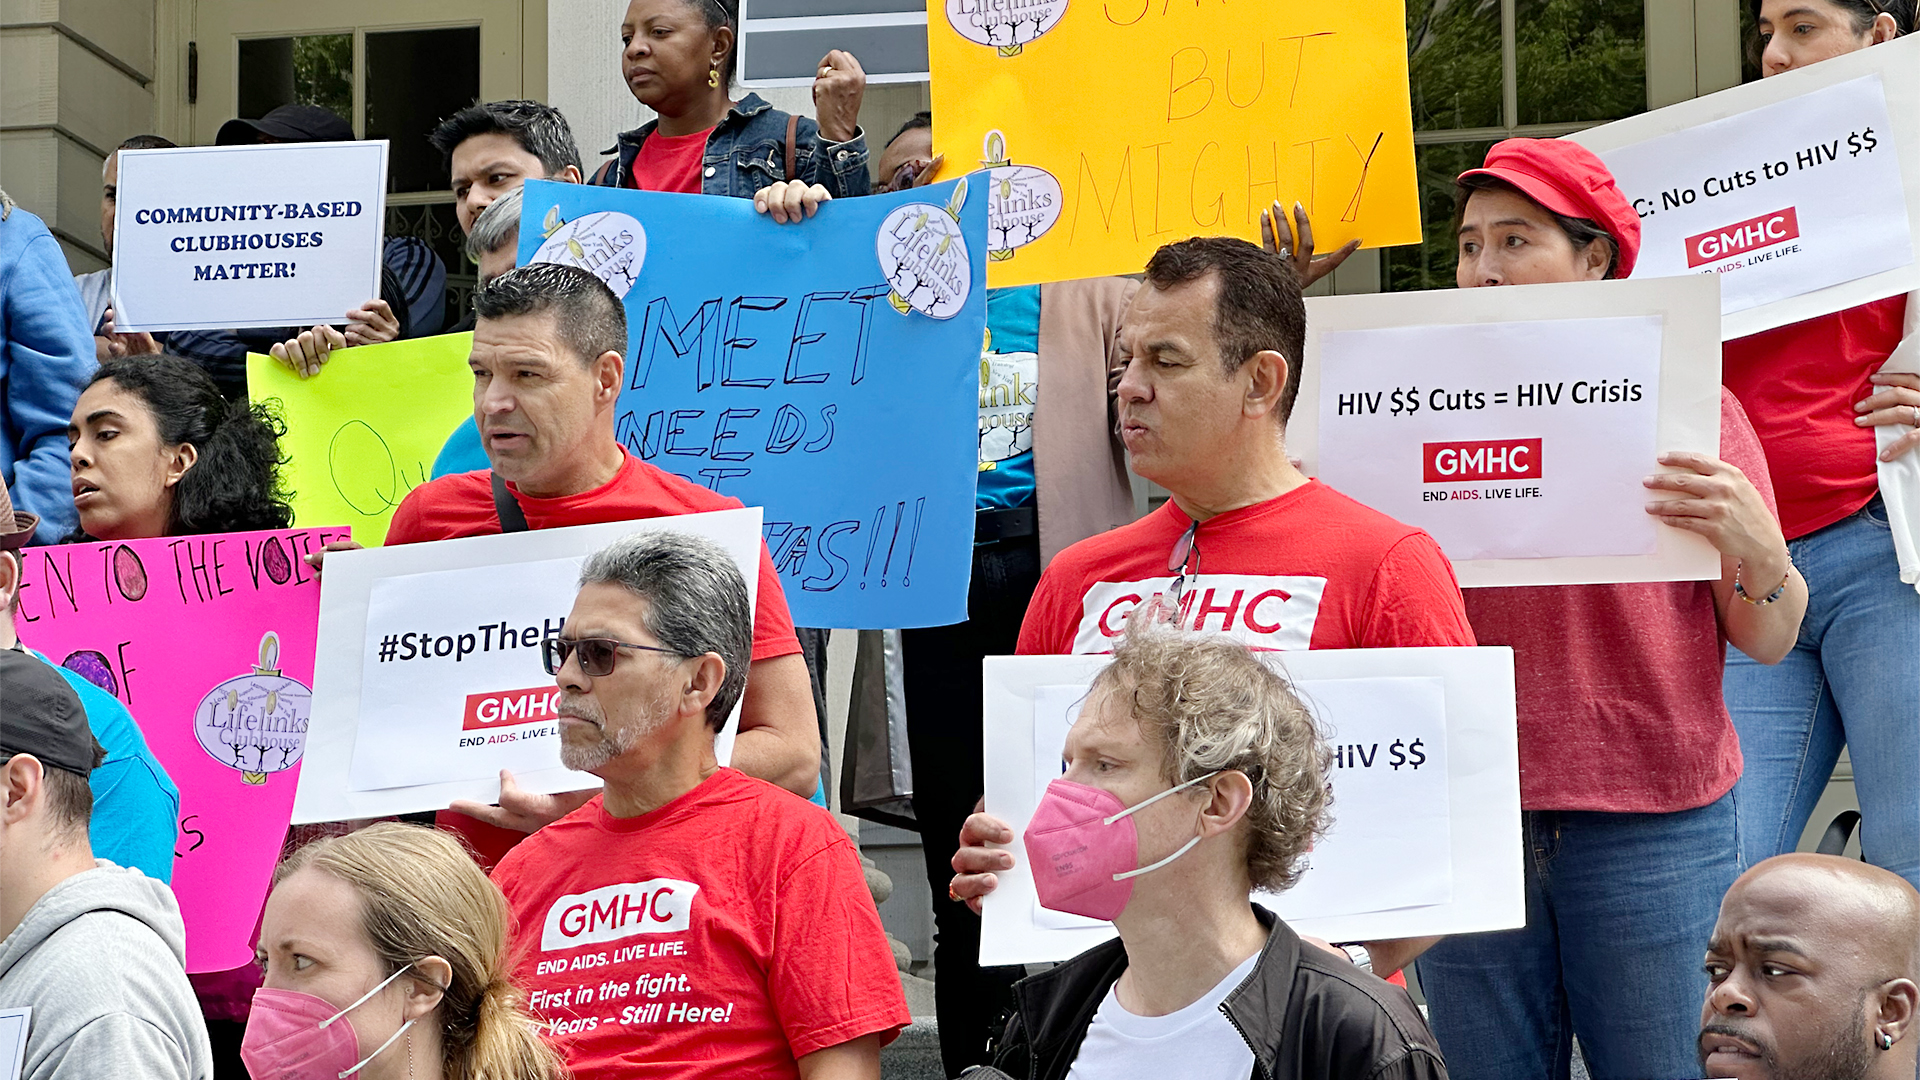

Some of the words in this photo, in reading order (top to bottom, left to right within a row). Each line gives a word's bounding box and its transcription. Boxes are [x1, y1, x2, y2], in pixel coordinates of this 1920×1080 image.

[970, 7, 1052, 28] Clubhouse
[1167, 31, 1337, 123] BUT
[1661, 187, 1696, 211] No
[1703, 169, 1757, 197] Cuts
[1762, 159, 1789, 180] to
[1796, 140, 1839, 170] HIV
[1847, 127, 1878, 157] $$
[1069, 132, 1383, 246] MIGHTY
[135, 201, 362, 224] COMMUNITY-BASED
[170, 232, 323, 253] CLUBHOUSES
[889, 212, 963, 296] Lifelinks
[1697, 216, 1786, 259] GMHC
[193, 262, 296, 281] MATTER!
[891, 242, 951, 302] Clubhouse
[1716, 261, 1746, 274] AIDS.
[1748, 252, 1773, 266] LIVE
[1775, 244, 1802, 259] LIFE.
[631, 283, 890, 392] MEET
[979, 371, 1038, 408] ink
[1338, 391, 1382, 415] HIV
[1390, 387, 1420, 416] $$
[1429, 388, 1486, 411] Cuts
[1494, 391, 1508, 404] =
[1517, 383, 1563, 407] HIV
[1571, 378, 1642, 403] Crisis
[614, 404, 837, 460] NEEDS
[1435, 446, 1530, 475] GMHC
[1423, 490, 1448, 501] END
[1450, 489, 1482, 501] AIDS.
[1485, 488, 1511, 499] LIVE
[1515, 487, 1543, 498] LIFE.
[99, 543, 148, 604] TO
[168, 540, 234, 604] THE
[207, 702, 309, 734] Lifelinks
[219, 728, 300, 749] Clubhouse
[459, 736, 485, 748] END
[487, 732, 519, 745] AIDS.
[522, 727, 548, 740] LIVE
[1389, 737, 1426, 770] $$
[559, 887, 675, 937] GMHC
[536, 958, 568, 975] END
[570, 952, 610, 971] AIDS.
[613, 944, 646, 964] LIVE
[649, 941, 688, 957] LIFE.
[529, 988, 572, 1011] First
[575, 984, 594, 1005] in
[599, 980, 630, 1001] the
[635, 972, 691, 998] fight.
[549, 1016, 599, 1037] Years
[619, 1003, 662, 1025] Still
[666, 1002, 733, 1023] Here!
